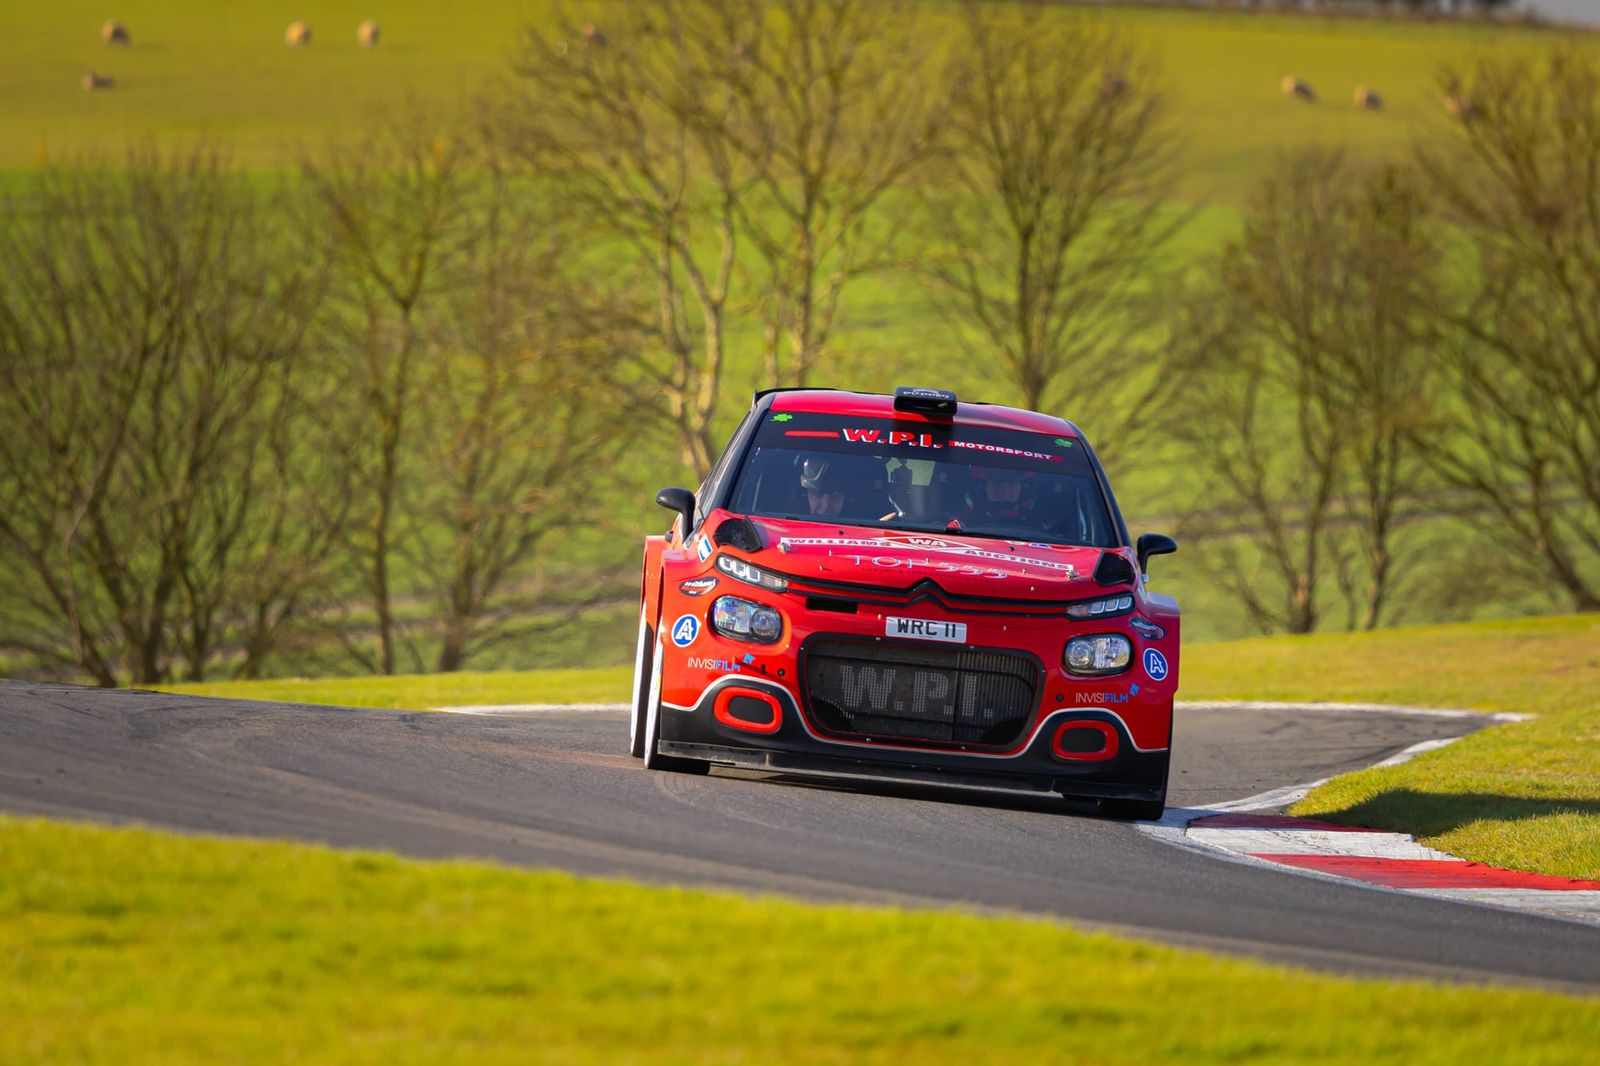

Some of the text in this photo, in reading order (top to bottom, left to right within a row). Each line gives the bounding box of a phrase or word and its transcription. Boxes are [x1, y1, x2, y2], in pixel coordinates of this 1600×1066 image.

[842, 428, 1053, 460] W.P.I. MOTORSPORT
[787, 537, 892, 547] WILLIAMS
[907, 537, 948, 548] WA
[963, 549, 1069, 570] AUCTIONS
[897, 618, 938, 637] WRC
[687, 655, 741, 673] INVISIFILM
[840, 664, 994, 720] W.P.I.
[1075, 691, 1129, 704] INVISIFILM
